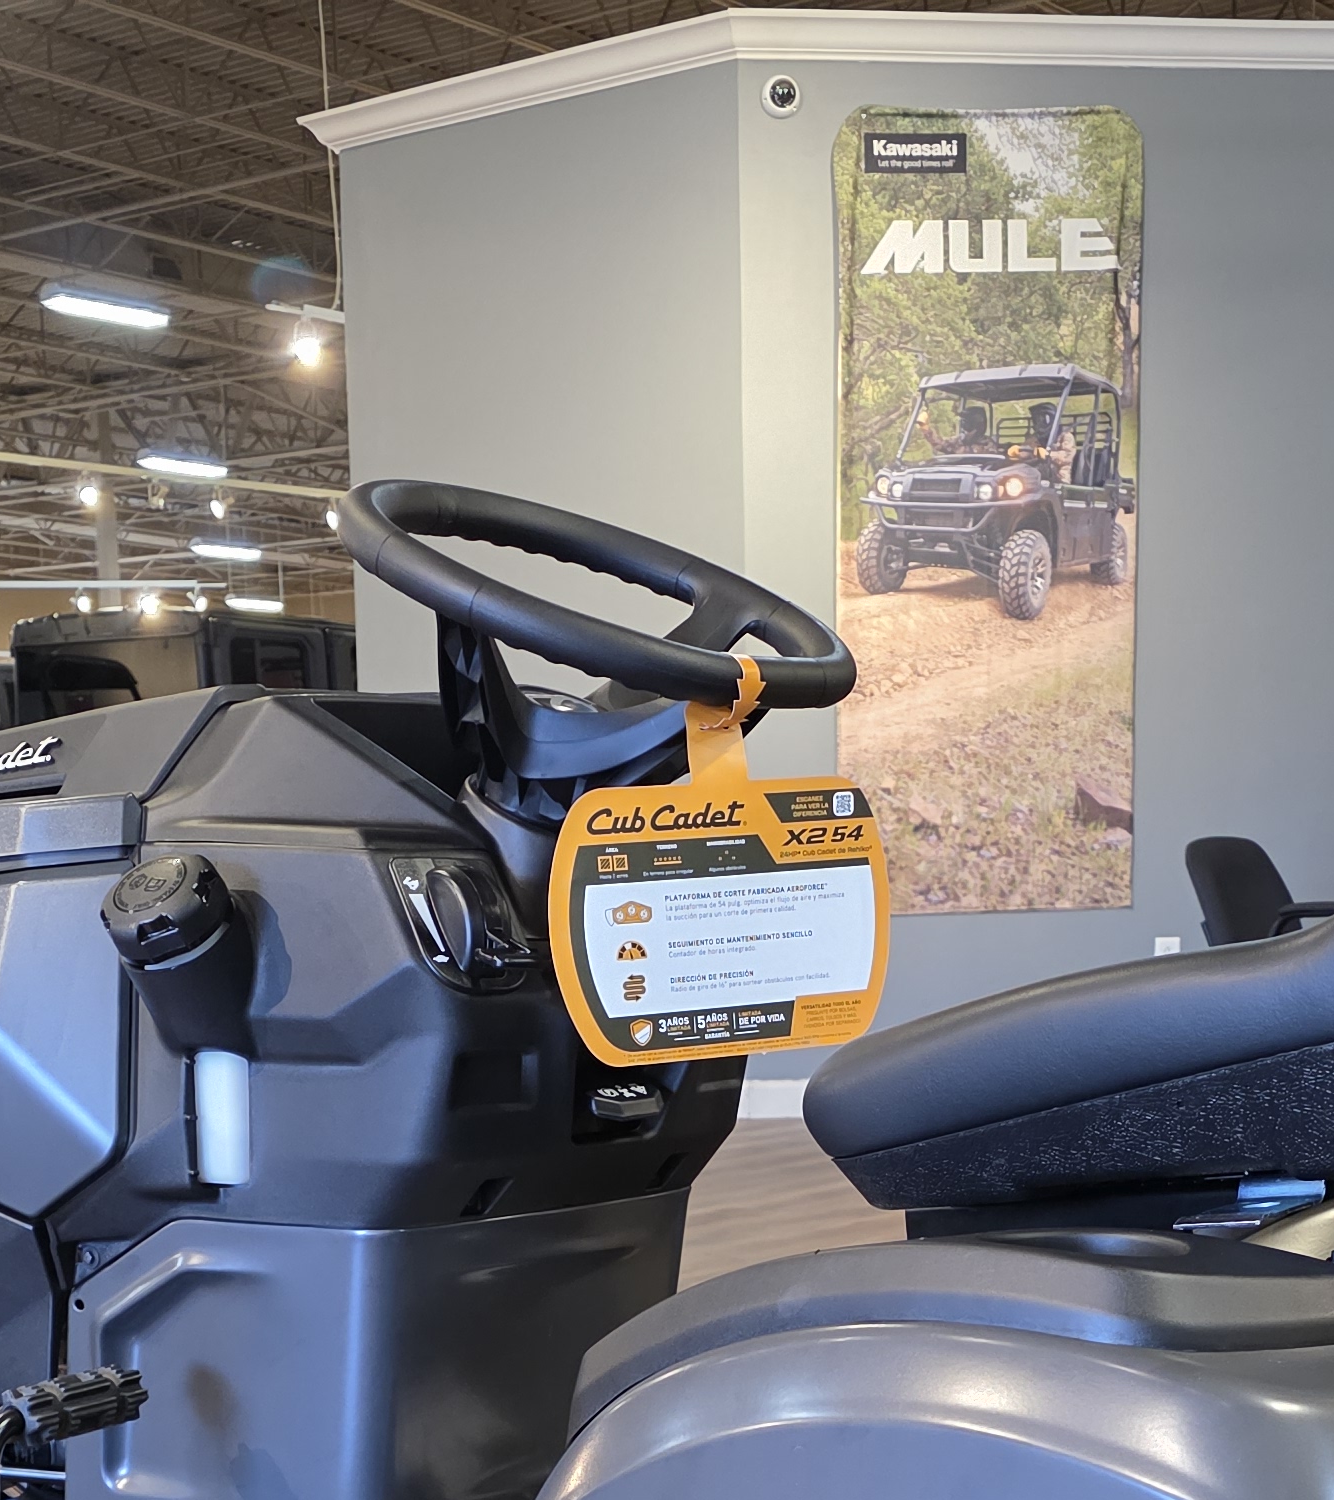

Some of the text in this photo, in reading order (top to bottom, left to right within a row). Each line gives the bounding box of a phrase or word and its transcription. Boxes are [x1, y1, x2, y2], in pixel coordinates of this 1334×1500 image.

[872, 139, 958, 157] Kawasaki
[903, 160, 921, 169] good
[860, 217, 1121, 275] MULE
[587, 801, 745, 835] Cub Cadet
[817, 848, 837, 856] Cadet
[665, 886, 785, 902] PLATAFORMA DE CORTE FABRICADA
[665, 904, 673, 912] La
[675, 904, 708, 912] plataforma
[727, 900, 742, 908] pulg.
[743, 897, 769, 907] optimiza
[777, 896, 791, 904] flujo
[813, 894, 817, 902] y
[817, 892, 845, 900] maximiza
[673, 912, 698, 921] succión
[699, 911, 713, 920] para
[713, 910, 723, 918] un
[723, 909, 740, 917] corte
[749, 906, 773, 916] primera
[774, 904, 797, 913] calidad.
[668, 938, 714, 949] SEGUIMIENTO
[727, 932, 781, 944] MANTENIMIENTO
[782, 930, 813, 939] SENCILLO
[668, 950, 697, 959] Contador
[707, 946, 726, 955] horas
[670, 974, 707, 984] DIRECCIÓN
[719, 969, 754, 980] PRECISIÓN
[697, 984, 709, 992] giro
[729, 981, 742, 989] para
[659, 1012, 786, 1033] 3 AÑOS 5 AÑOS DE POR VIDA
